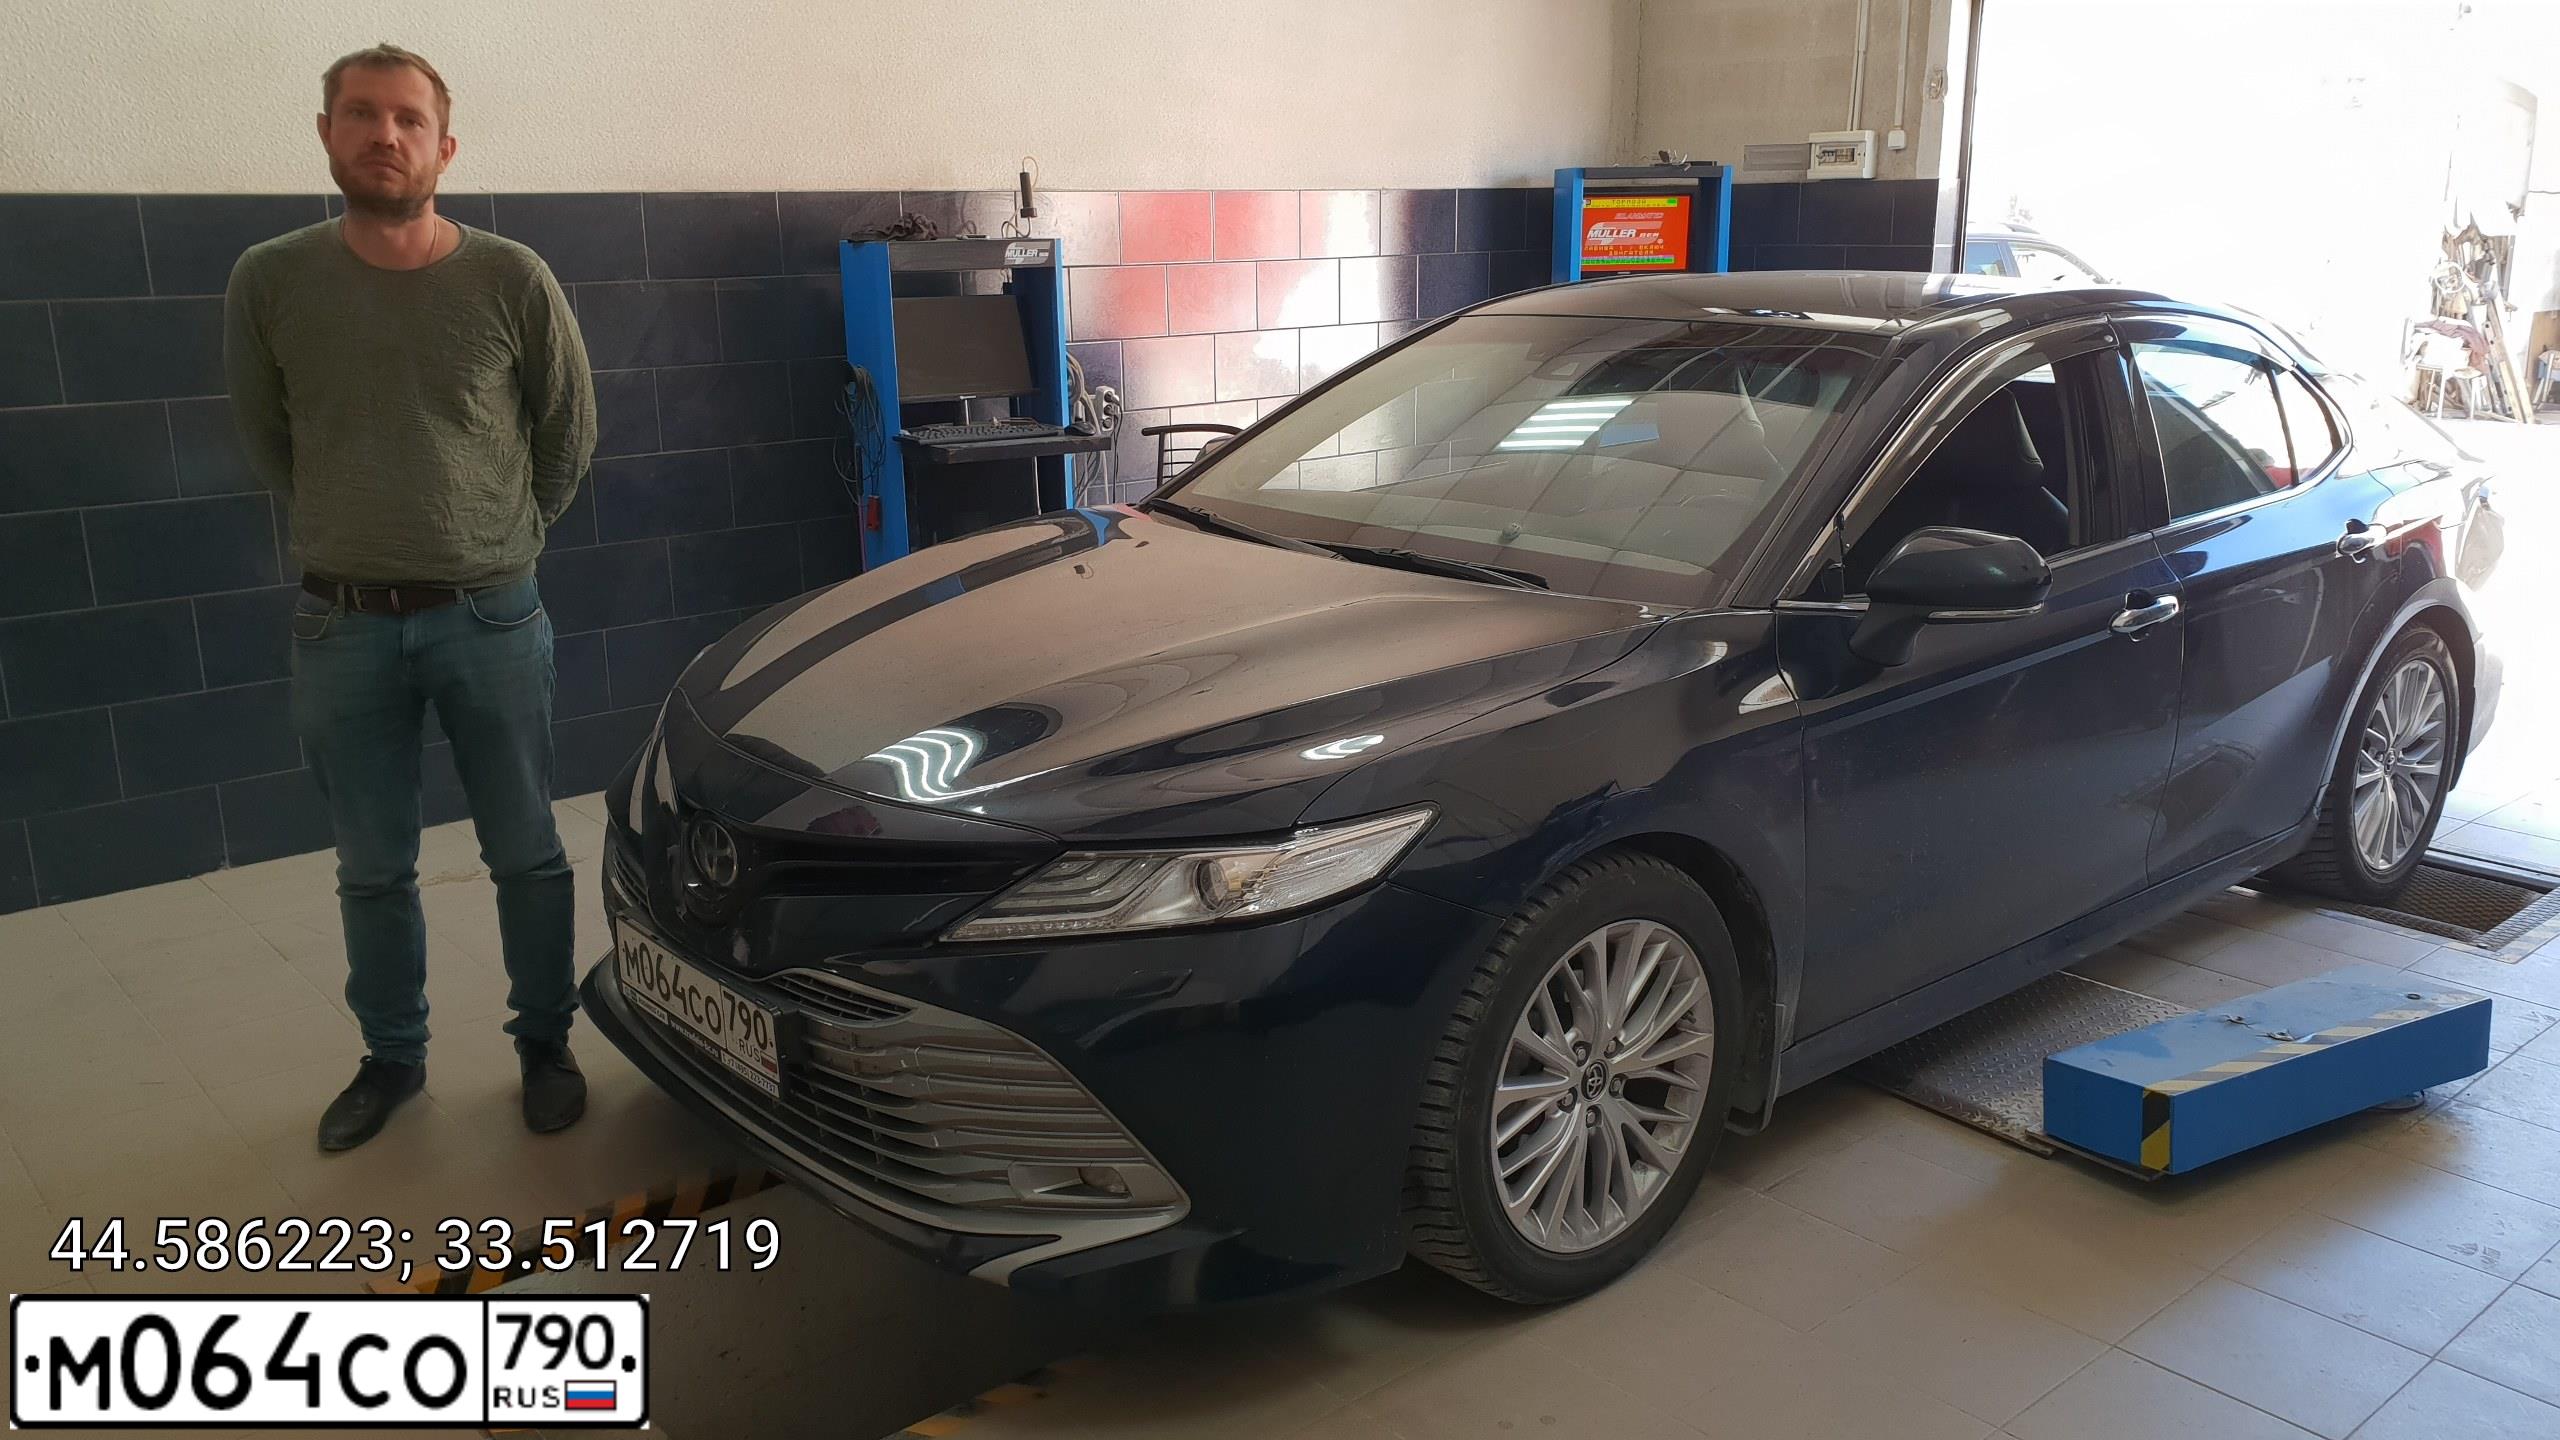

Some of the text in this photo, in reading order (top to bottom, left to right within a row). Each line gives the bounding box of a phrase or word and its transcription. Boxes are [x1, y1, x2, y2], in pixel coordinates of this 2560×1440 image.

[1587, 228, 1637, 239] MULLER
[1004, 249, 1038, 258] MULLER
[723, 991, 768, 1051] 790
[739, 1038, 761, 1062] RUS
